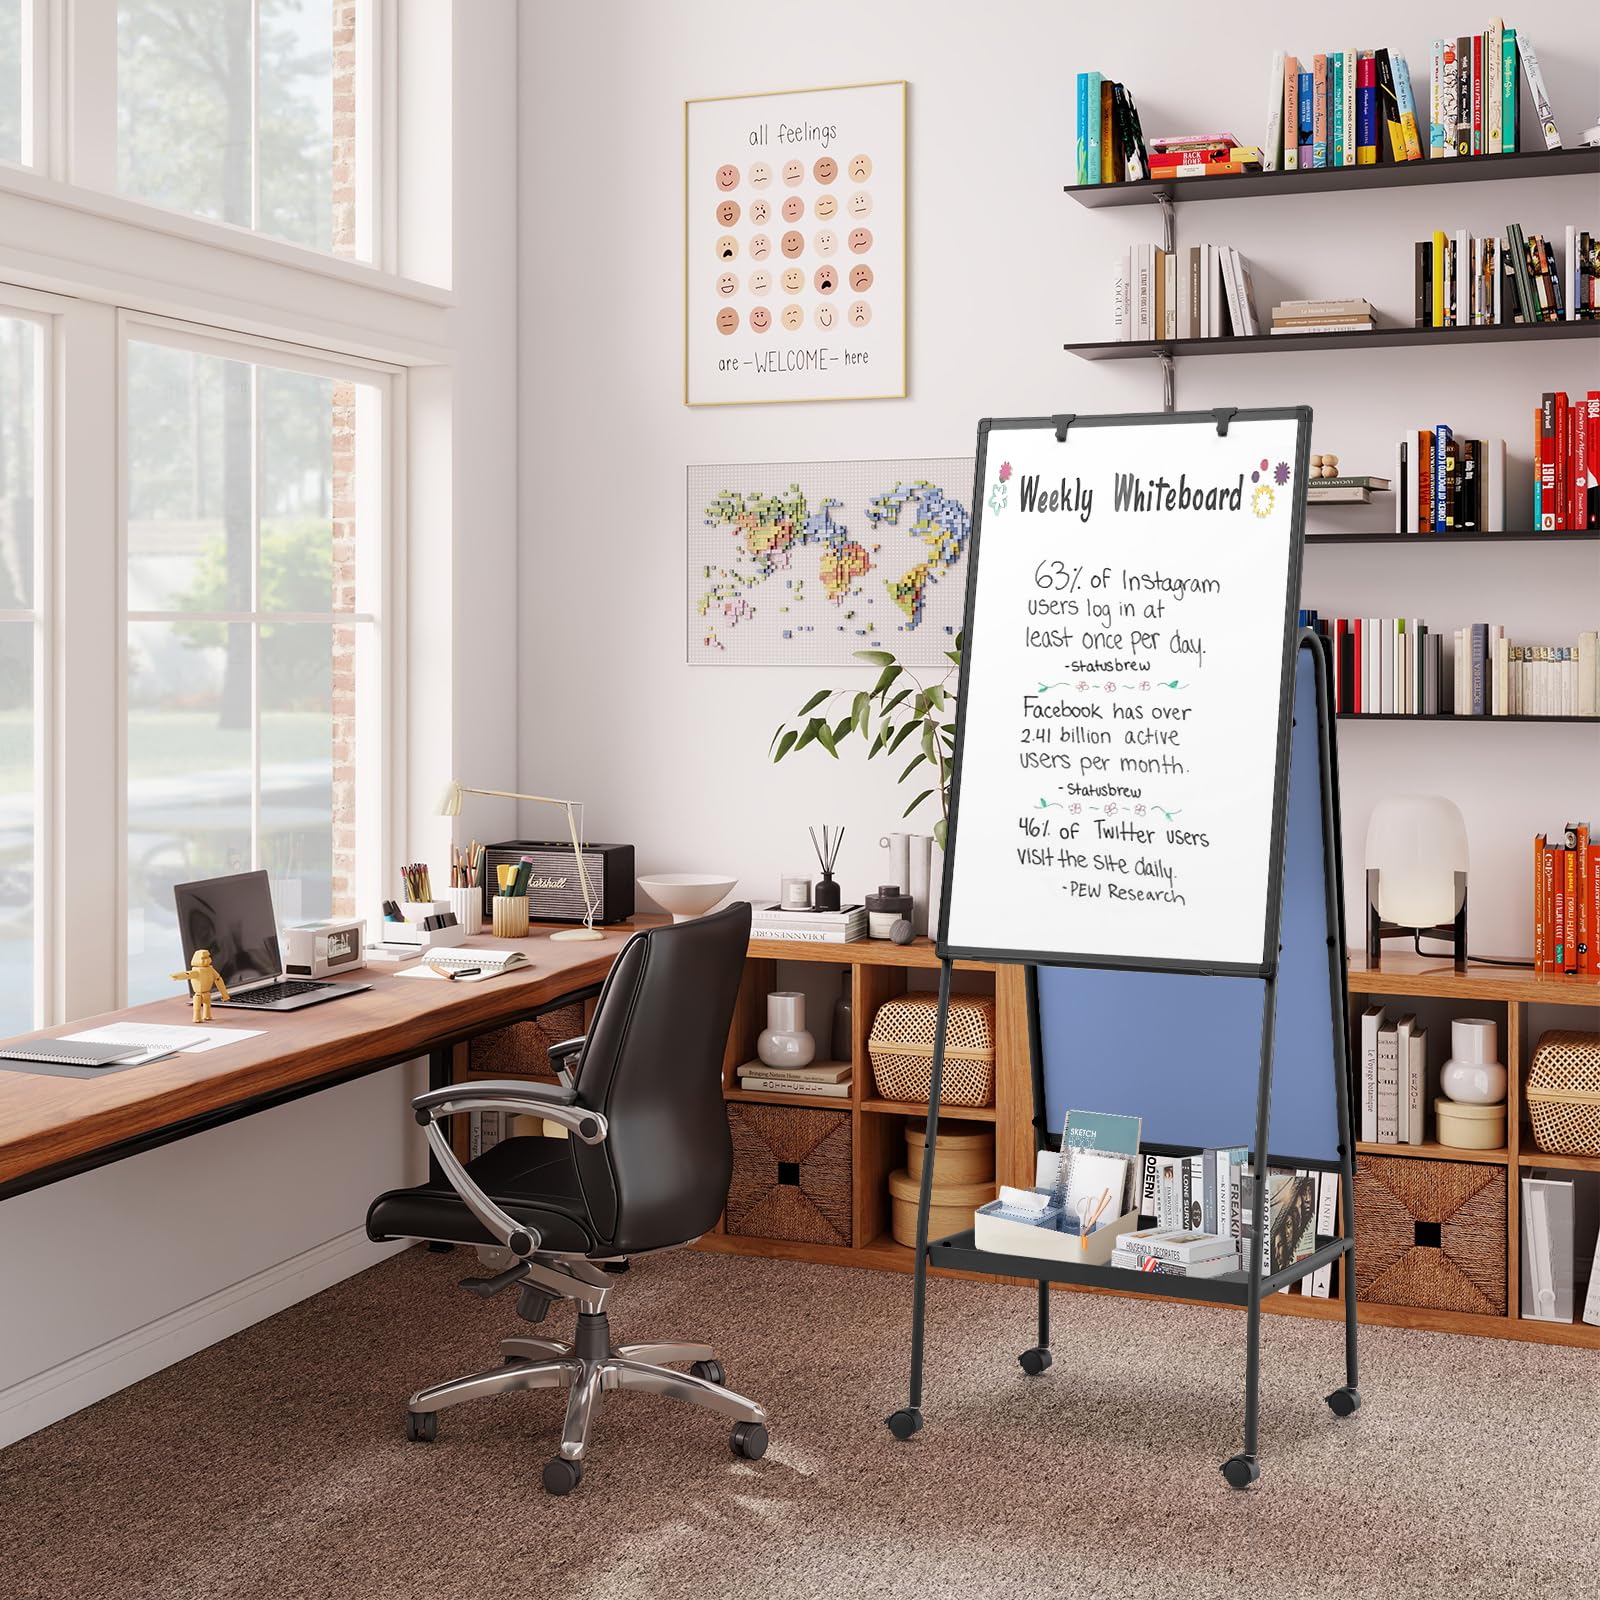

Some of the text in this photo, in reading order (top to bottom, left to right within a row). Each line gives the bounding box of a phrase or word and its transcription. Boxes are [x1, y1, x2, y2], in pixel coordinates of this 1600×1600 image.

[749, 120, 837, 148] all feelings
[1183, 151, 1202, 159] BACK
[1114, 278, 1123, 325] NOGUCHI
[718, 358, 739, 371] are
[845, 348, 869, 366] here
[1578, 406, 1586, 431] Flowers
[1587, 398, 1600, 419] 1984
[1576, 440, 1586, 471] Algernon
[1542, 463, 1555, 489] 1984
[1019, 471, 1245, 523] Weekly Whiteboard
[1438, 501, 1447, 522] FOREX:
[1034, 559, 1221, 601] 63% of Instagram
[1027, 598, 1165, 628] users log in at
[1025, 626, 1207, 668] least once per day.
[1023, 695, 1192, 721] Facebook has over
[1020, 726, 1181, 746] 2.41 billion active
[1019, 752, 1190, 776] users per month.
[1018, 817, 1210, 847] 46% of Twitter users
[1017, 847, 1177, 888] visit the site daily.
[1108, 883, 1186, 906] Research
[774, 931, 826, 941] JOHANNES
[749, 1070, 769, 1078] Bringing
[1364, 1049, 1375, 1113] Le Voyage botanique
[1070, 1127, 1097, 1138] SKETCH
[1125, 1241, 1151, 1255] HOUSEHOLD
[1153, 1245, 1181, 1261] DECORATES
